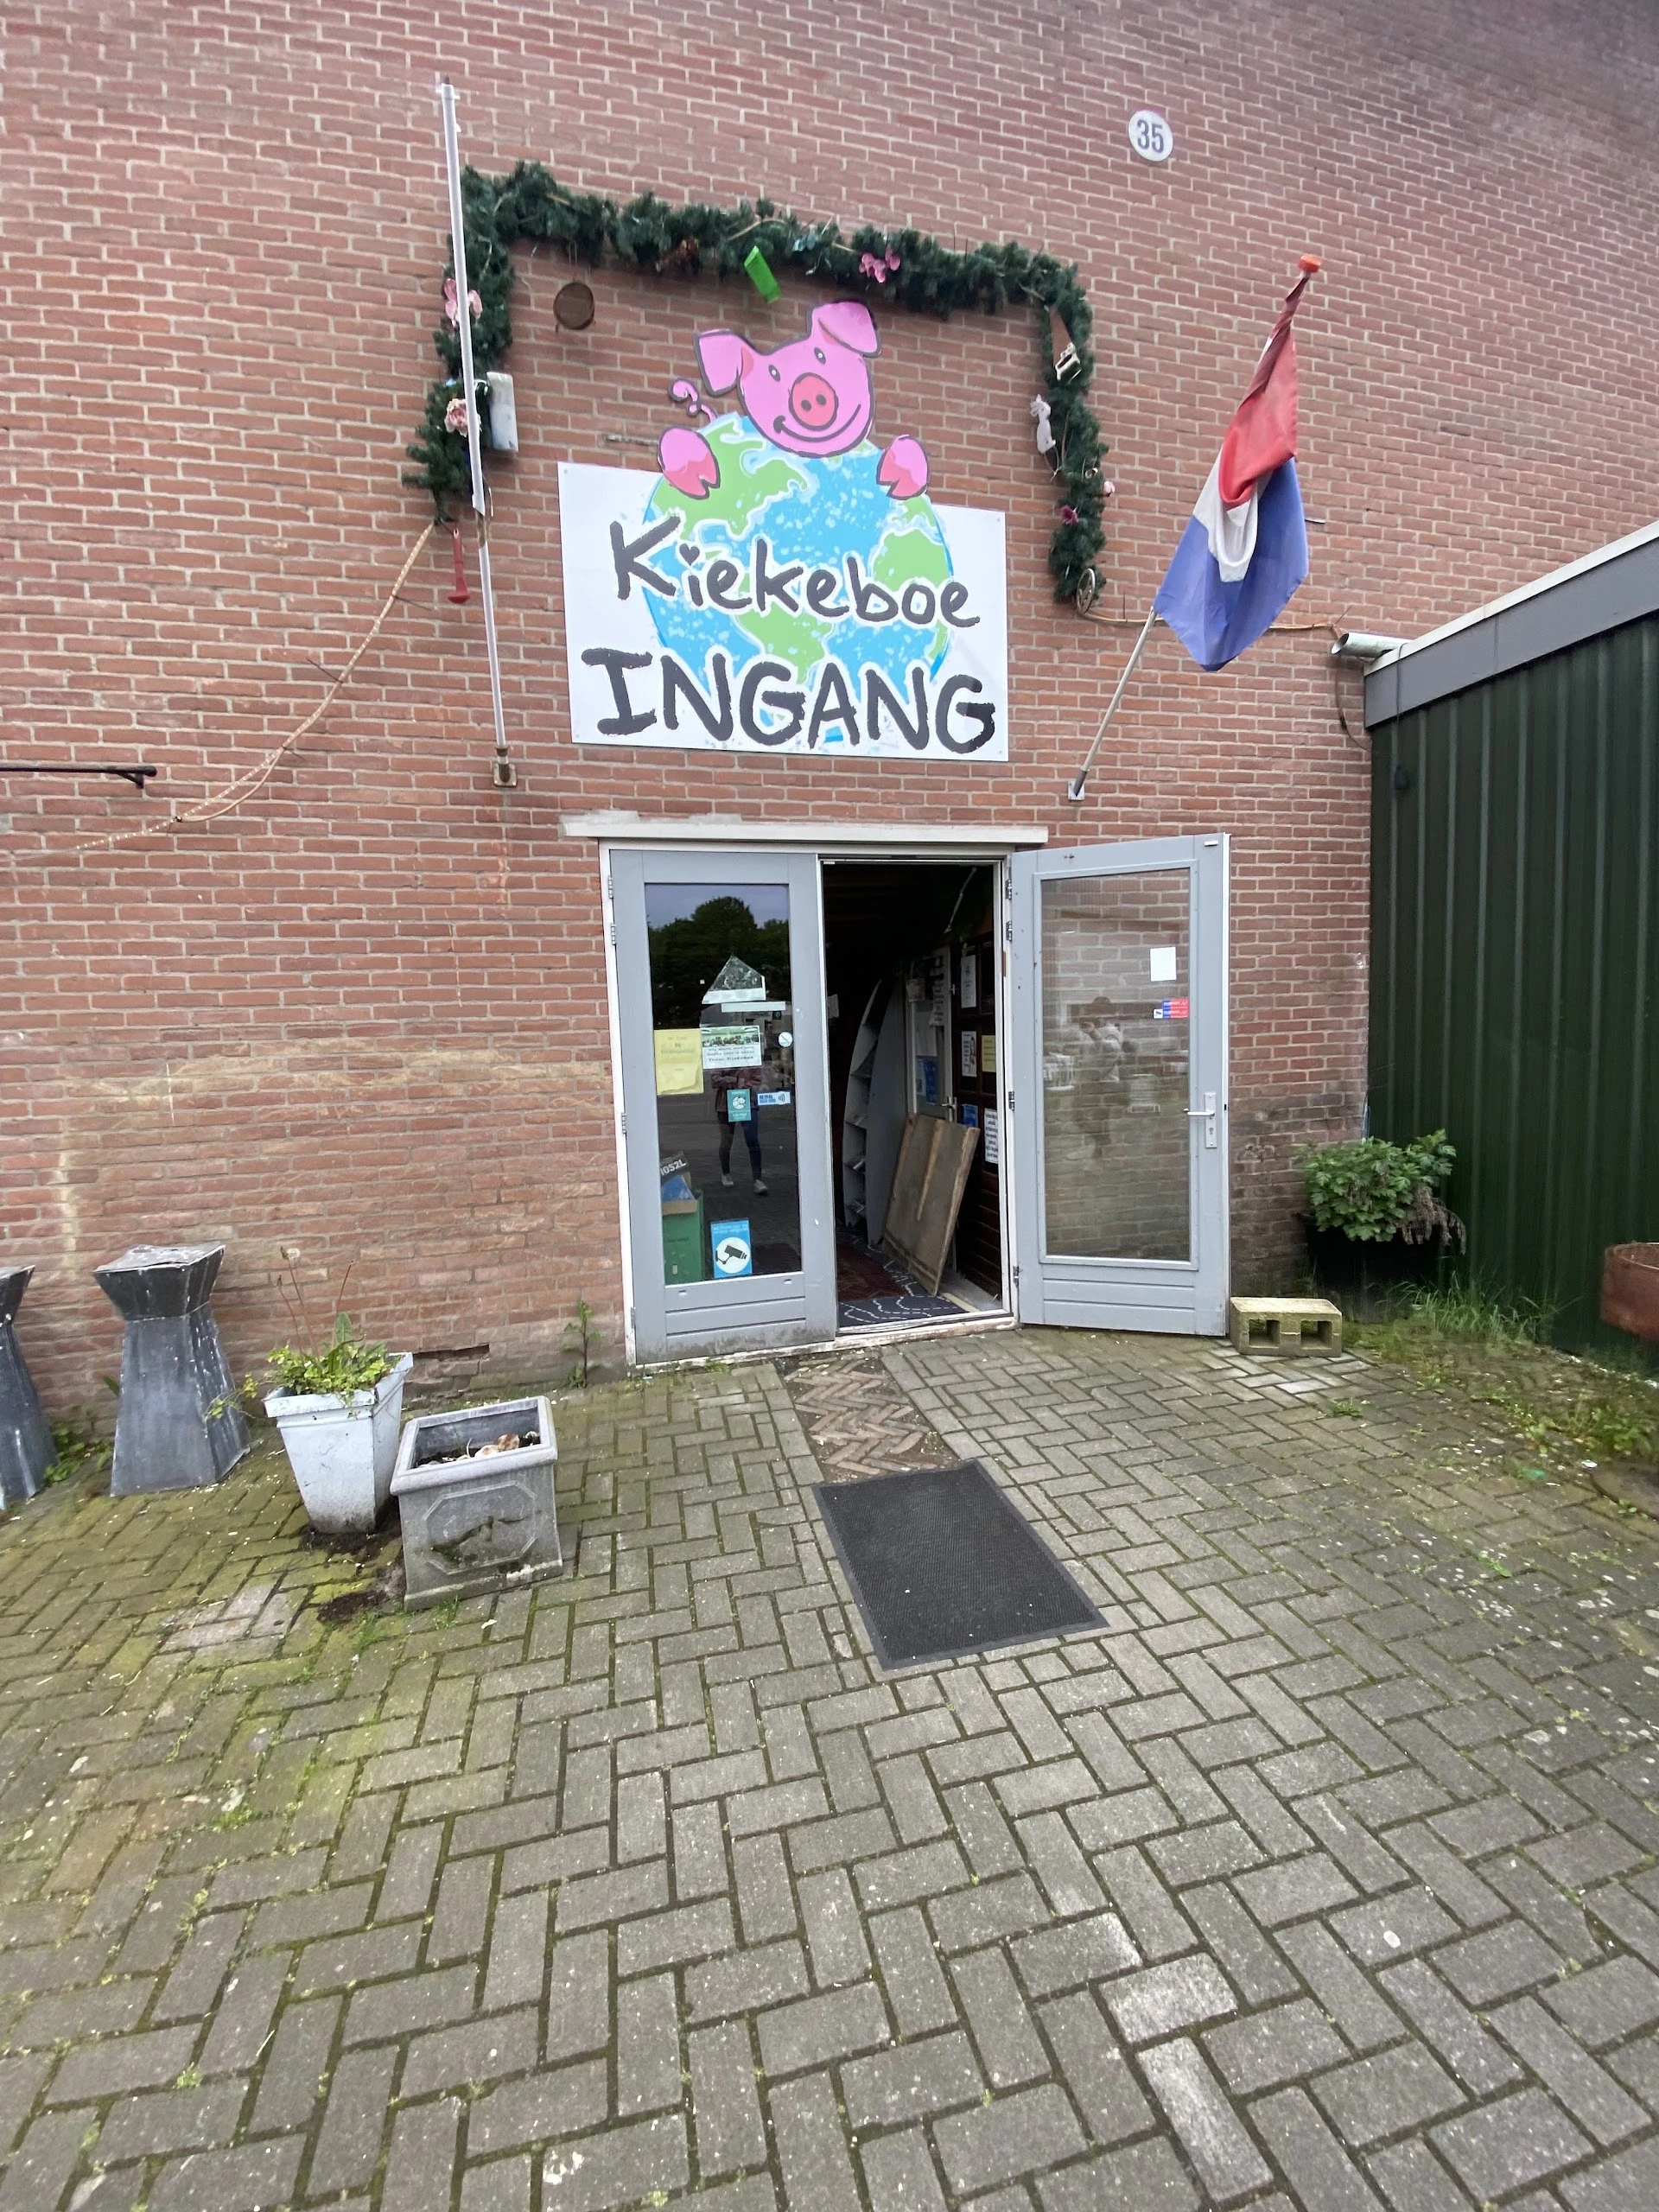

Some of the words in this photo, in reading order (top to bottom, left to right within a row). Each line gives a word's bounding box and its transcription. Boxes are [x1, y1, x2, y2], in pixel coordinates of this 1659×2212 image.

[1136, 119, 1165, 154] 35
[608, 516, 981, 628] Kiekeboe
[581, 646, 995, 754] INGANG
